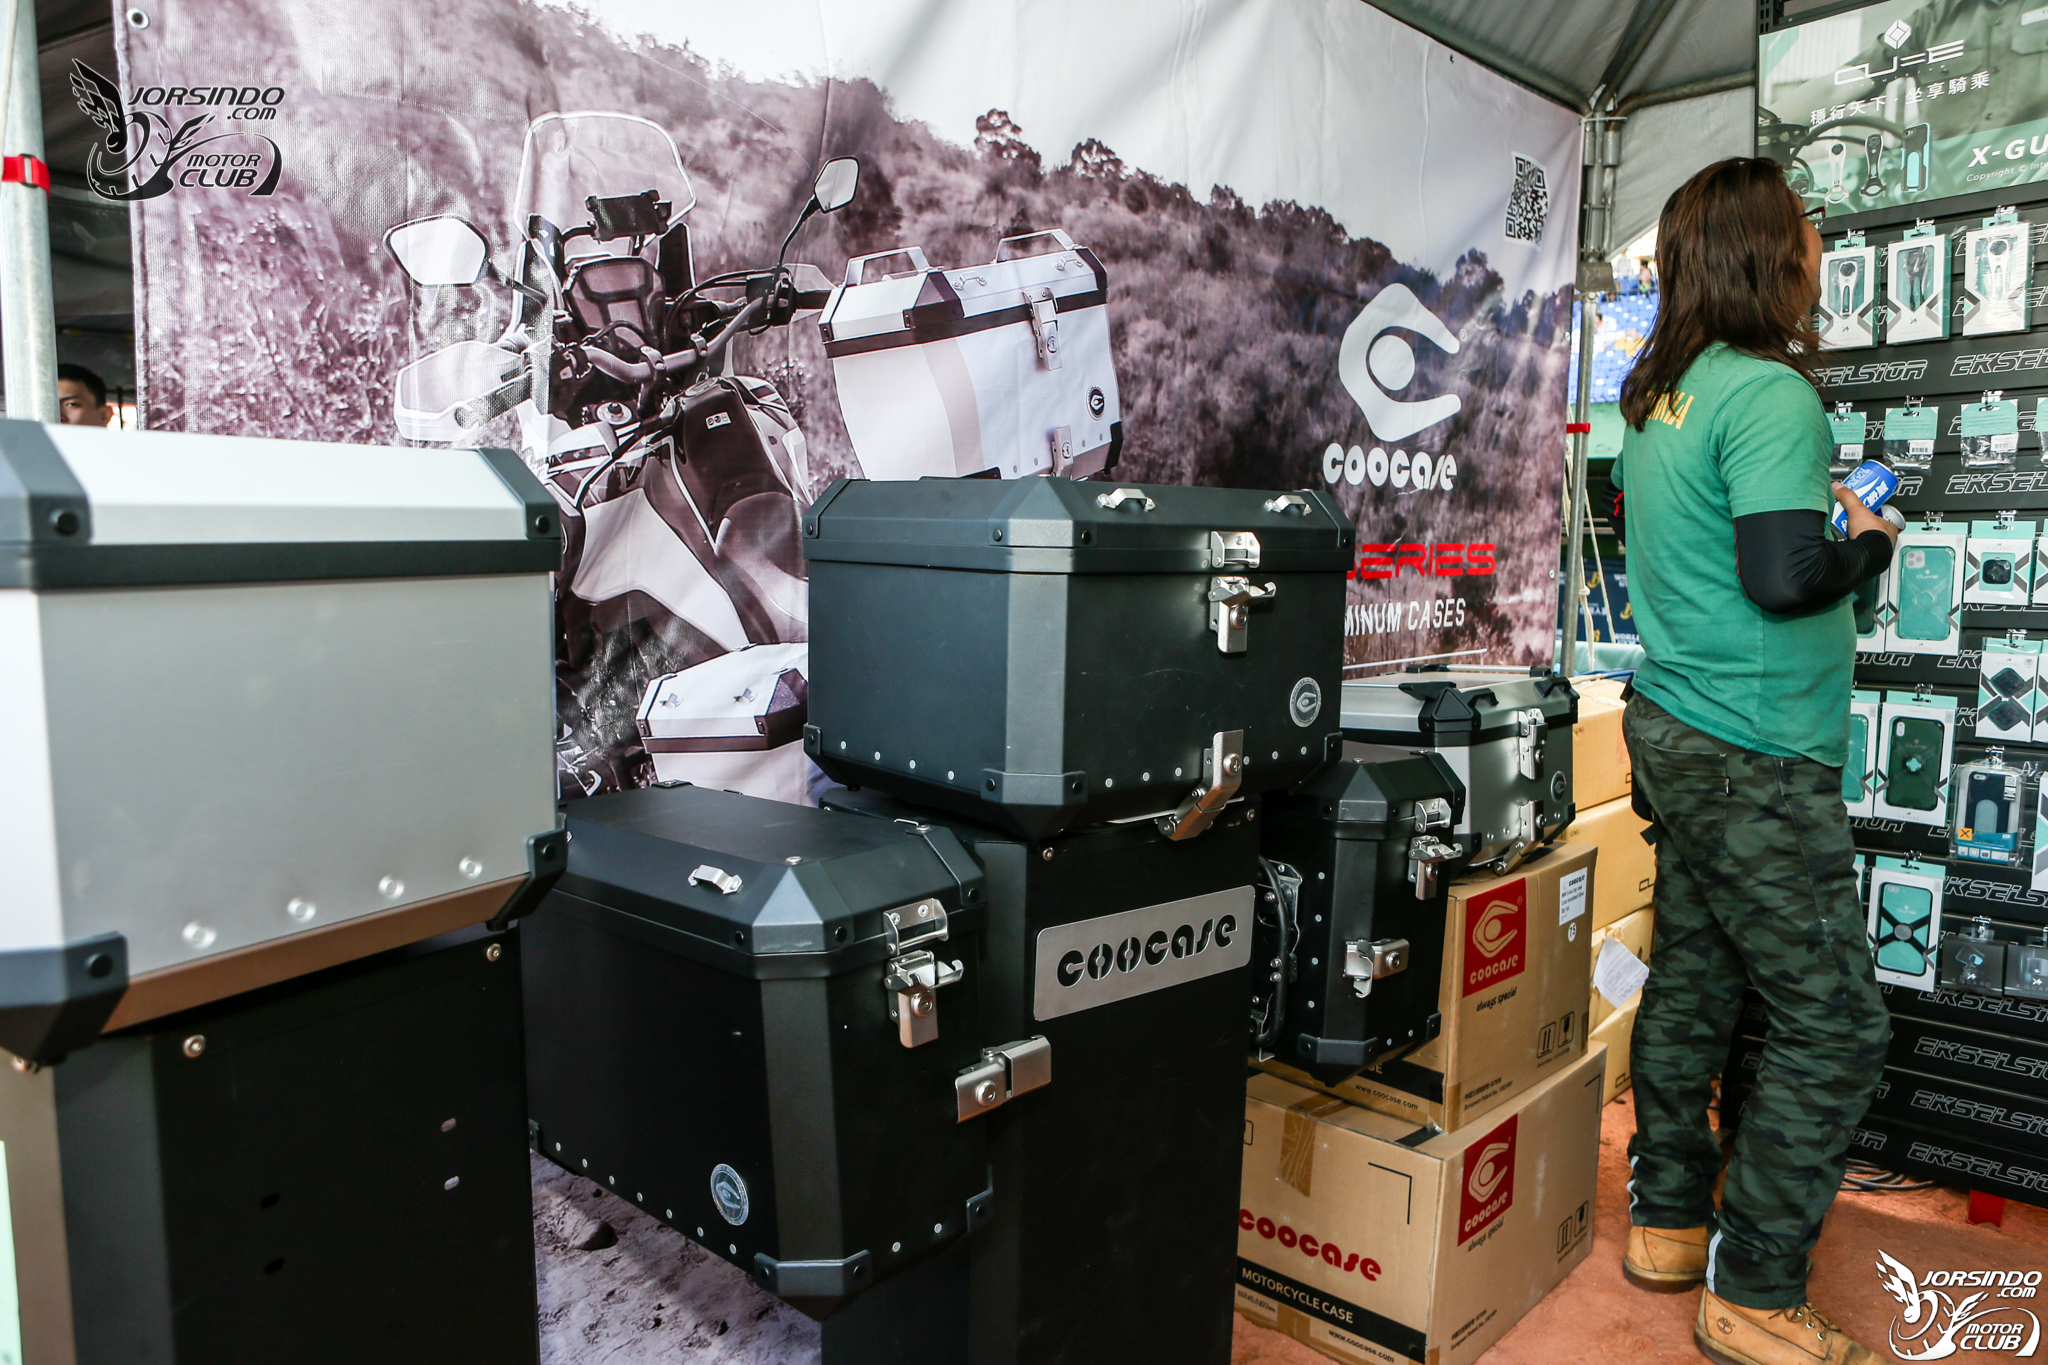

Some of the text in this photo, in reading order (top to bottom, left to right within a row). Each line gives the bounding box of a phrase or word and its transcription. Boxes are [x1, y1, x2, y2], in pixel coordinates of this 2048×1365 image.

[1966, 167, 2014, 182] Copyright
[1322, 442, 1458, 491] coocase
[1407, 597, 1466, 632] CASES
[1057, 914, 1238, 988] coocase
[1470, 954, 1519, 985] coocase
[1476, 986, 1518, 1012] always special
[1355, 1084, 1419, 1110] www.coocase.com
[1464, 1191, 1508, 1233] coocase
[1238, 1208, 1382, 1281] coocase
[1241, 1267, 1354, 1324] MOTORCYCLE CASE
[1328, 1329, 1395, 1363] www.coocase.com
